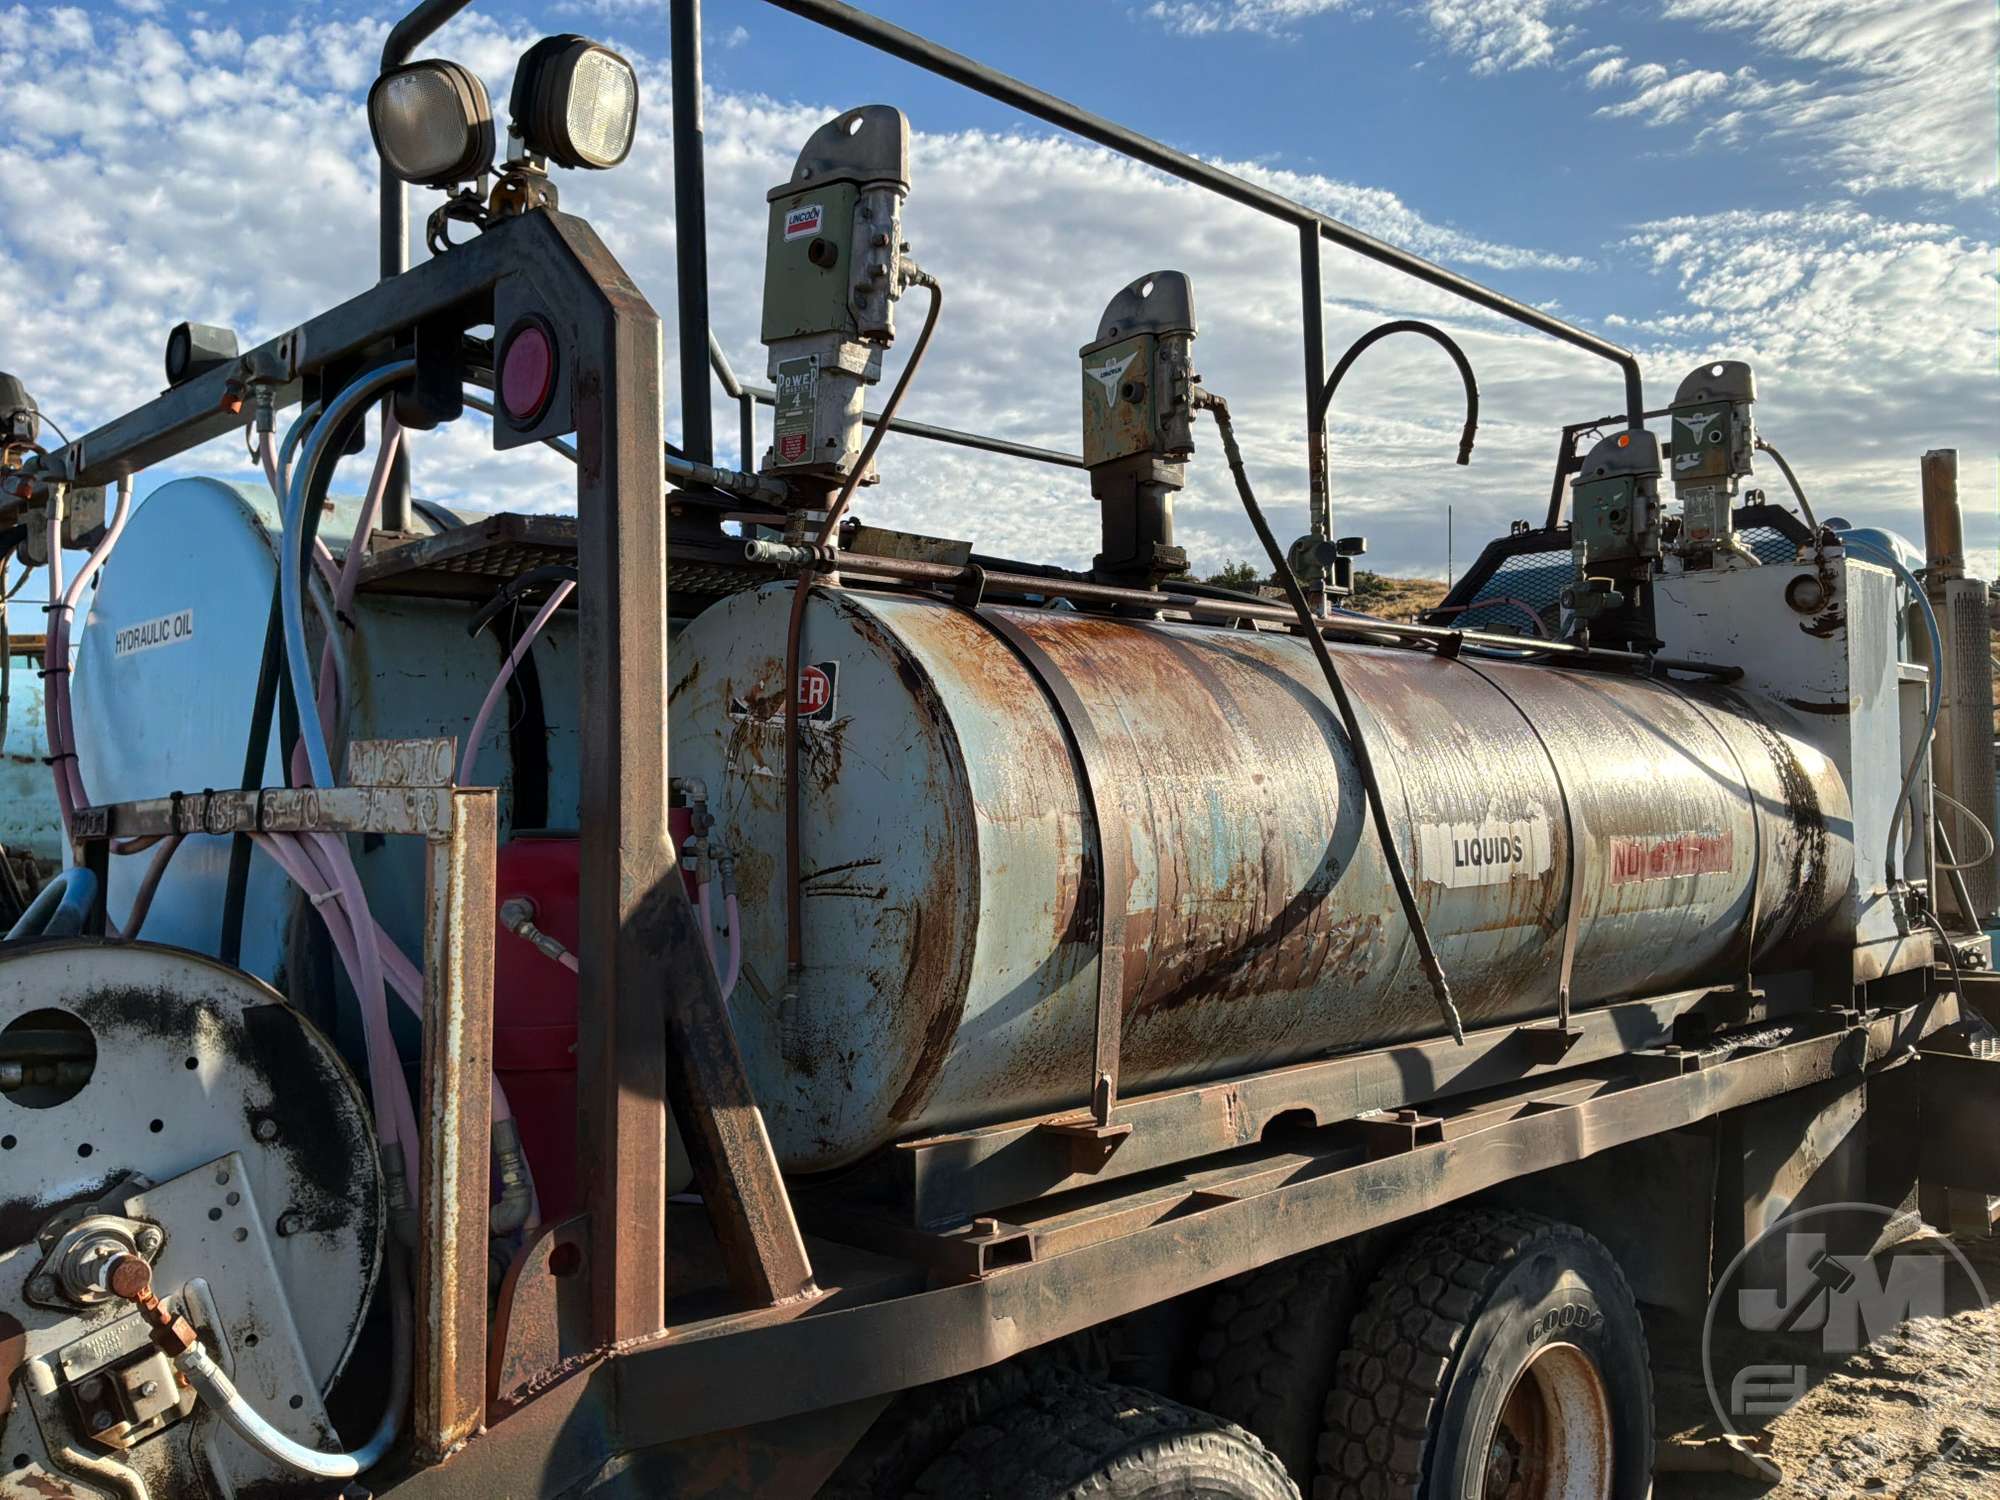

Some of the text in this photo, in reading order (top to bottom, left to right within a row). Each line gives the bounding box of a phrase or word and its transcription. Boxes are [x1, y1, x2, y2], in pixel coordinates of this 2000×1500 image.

[788, 207, 820, 224] LINCOLN
[776, 367, 817, 404] POWER
[792, 392, 801, 408] 4
[115, 613, 192, 654] HYDRAULIC OIL
[1454, 835, 1523, 867] LIQUIDS
